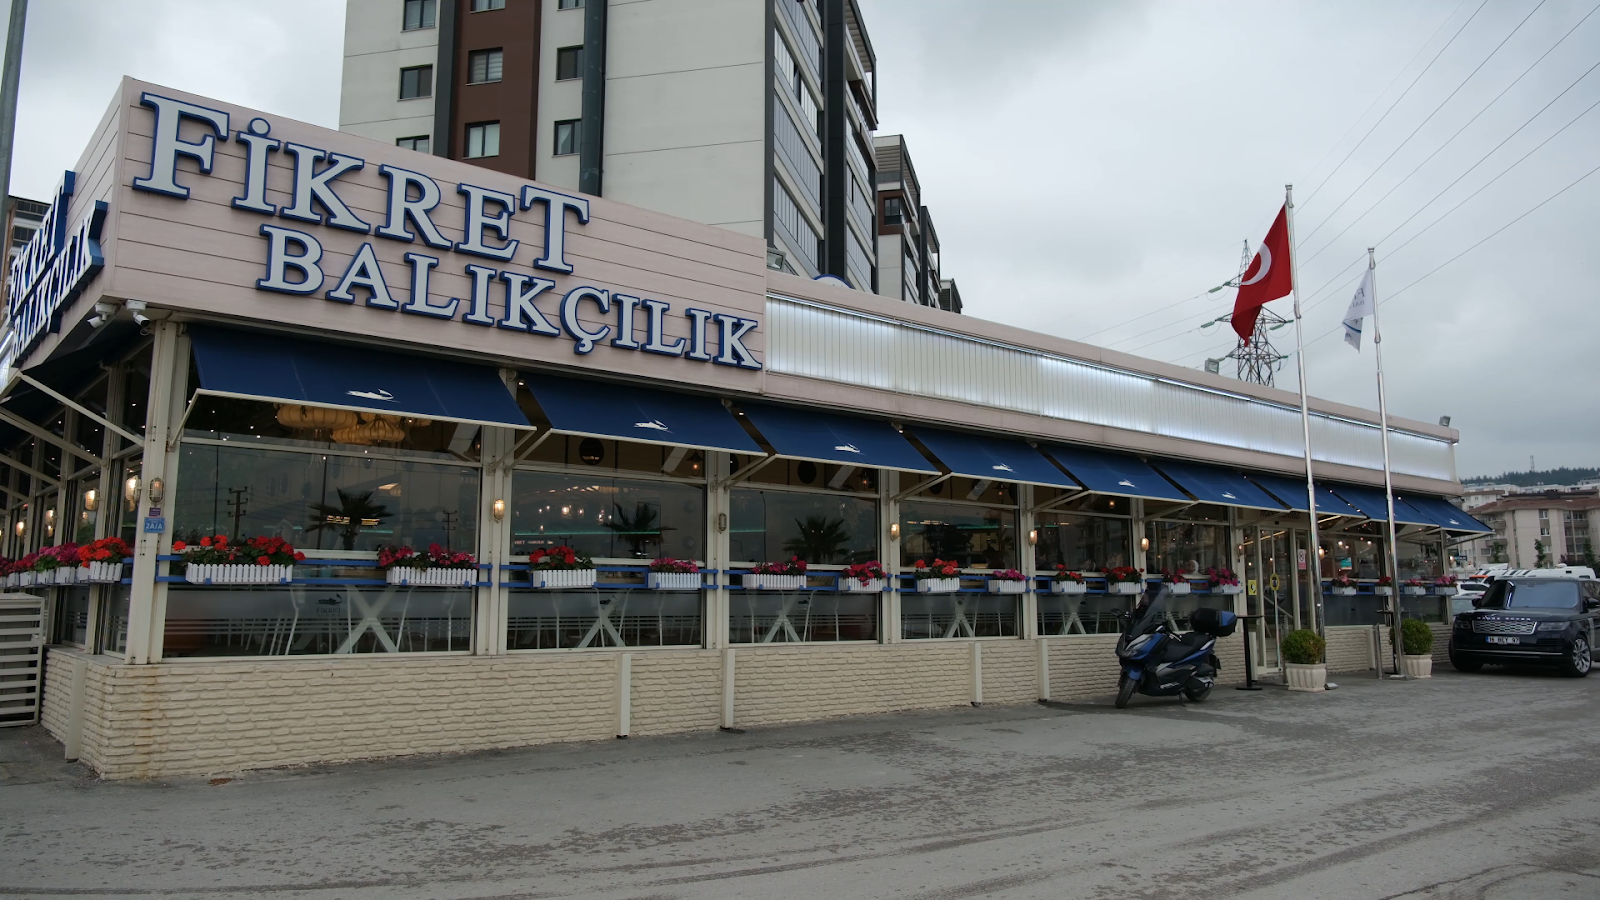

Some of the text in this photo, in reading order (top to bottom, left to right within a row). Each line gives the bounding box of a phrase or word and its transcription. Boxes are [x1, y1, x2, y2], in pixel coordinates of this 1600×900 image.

[132, 91, 589, 274] FİKRET
[256, 224, 763, 370] BALIKÇILIK
[145, 522, 163, 530] 2A/A
